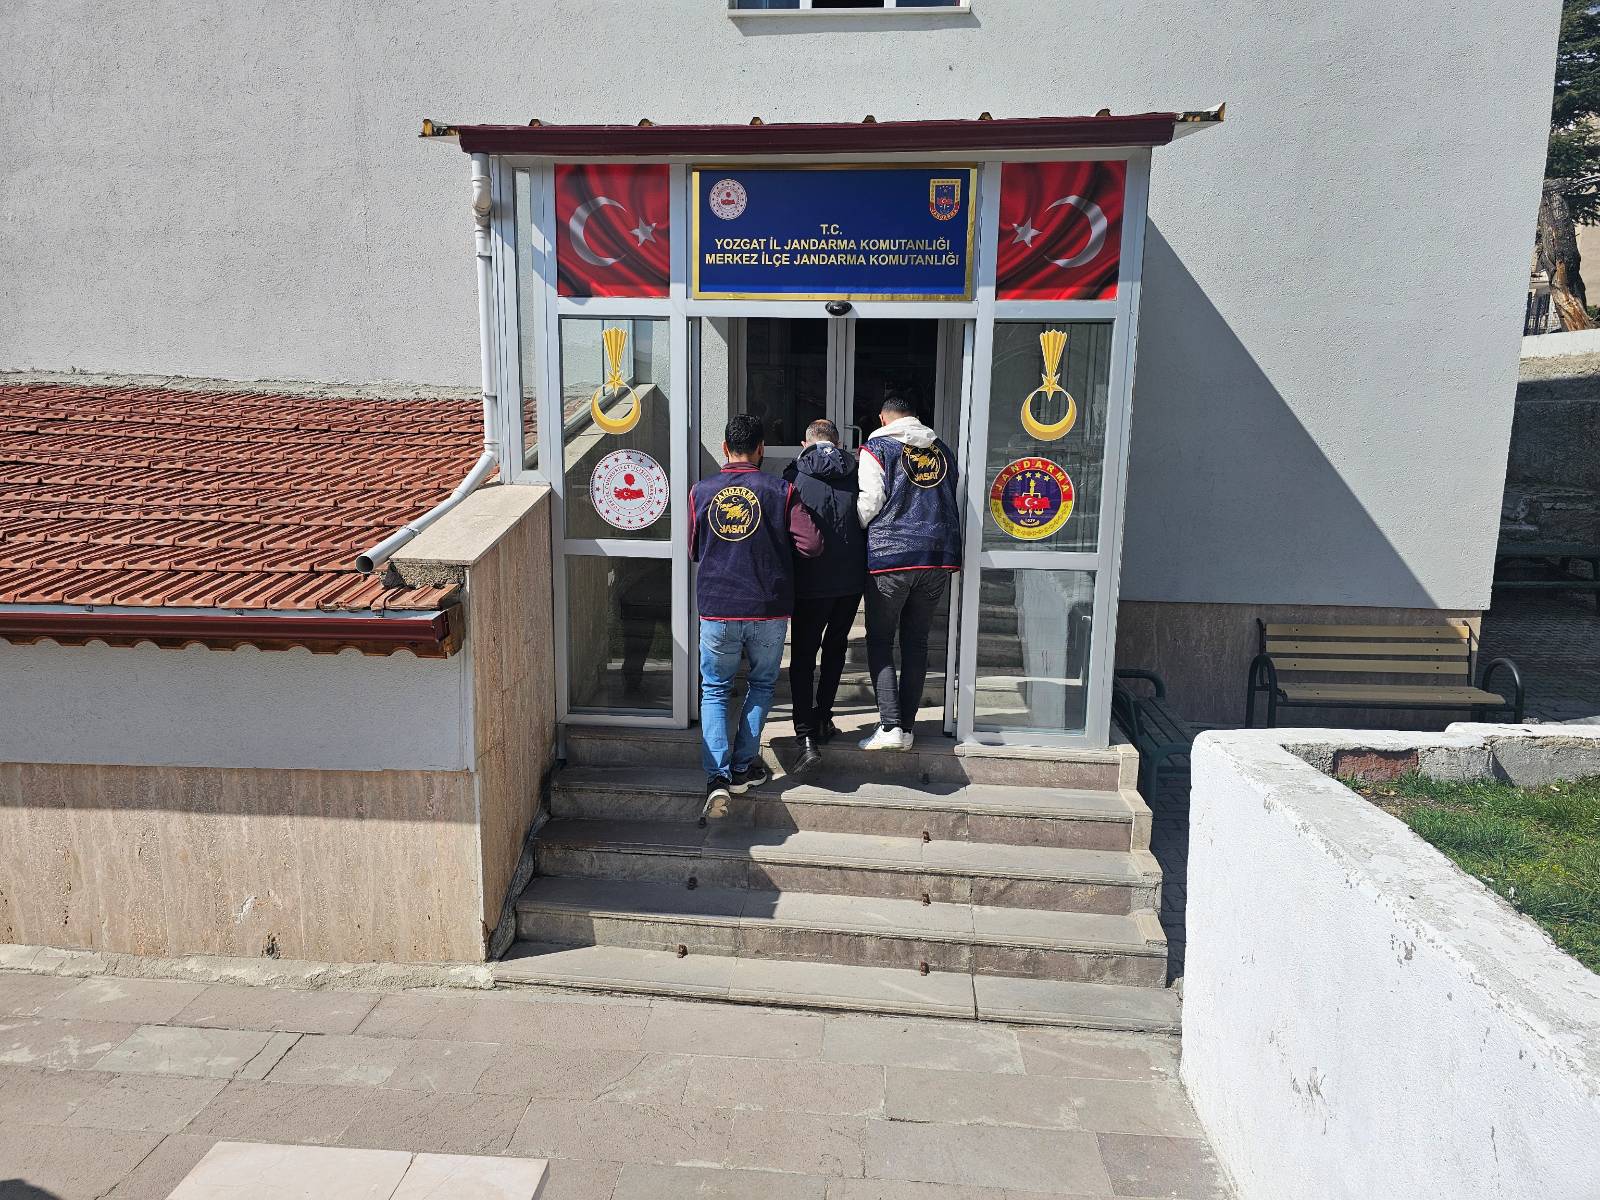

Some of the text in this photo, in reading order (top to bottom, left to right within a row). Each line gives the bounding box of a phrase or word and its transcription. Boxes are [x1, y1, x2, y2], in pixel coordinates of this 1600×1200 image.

[820, 224, 843, 235] T.C.
[715, 236, 950, 251] YOZGAT İL JANDARMA KOMUTANLIĞI
[705, 251, 960, 267] MERKEZ İLÇE JANDARMA KOMUTANLIĞI
[915, 471, 938, 482] JASAT
[995, 460, 1070, 492] JANDARMA
[713, 488, 757, 506] JANDARMA
[719, 524, 749, 534] JASAT
